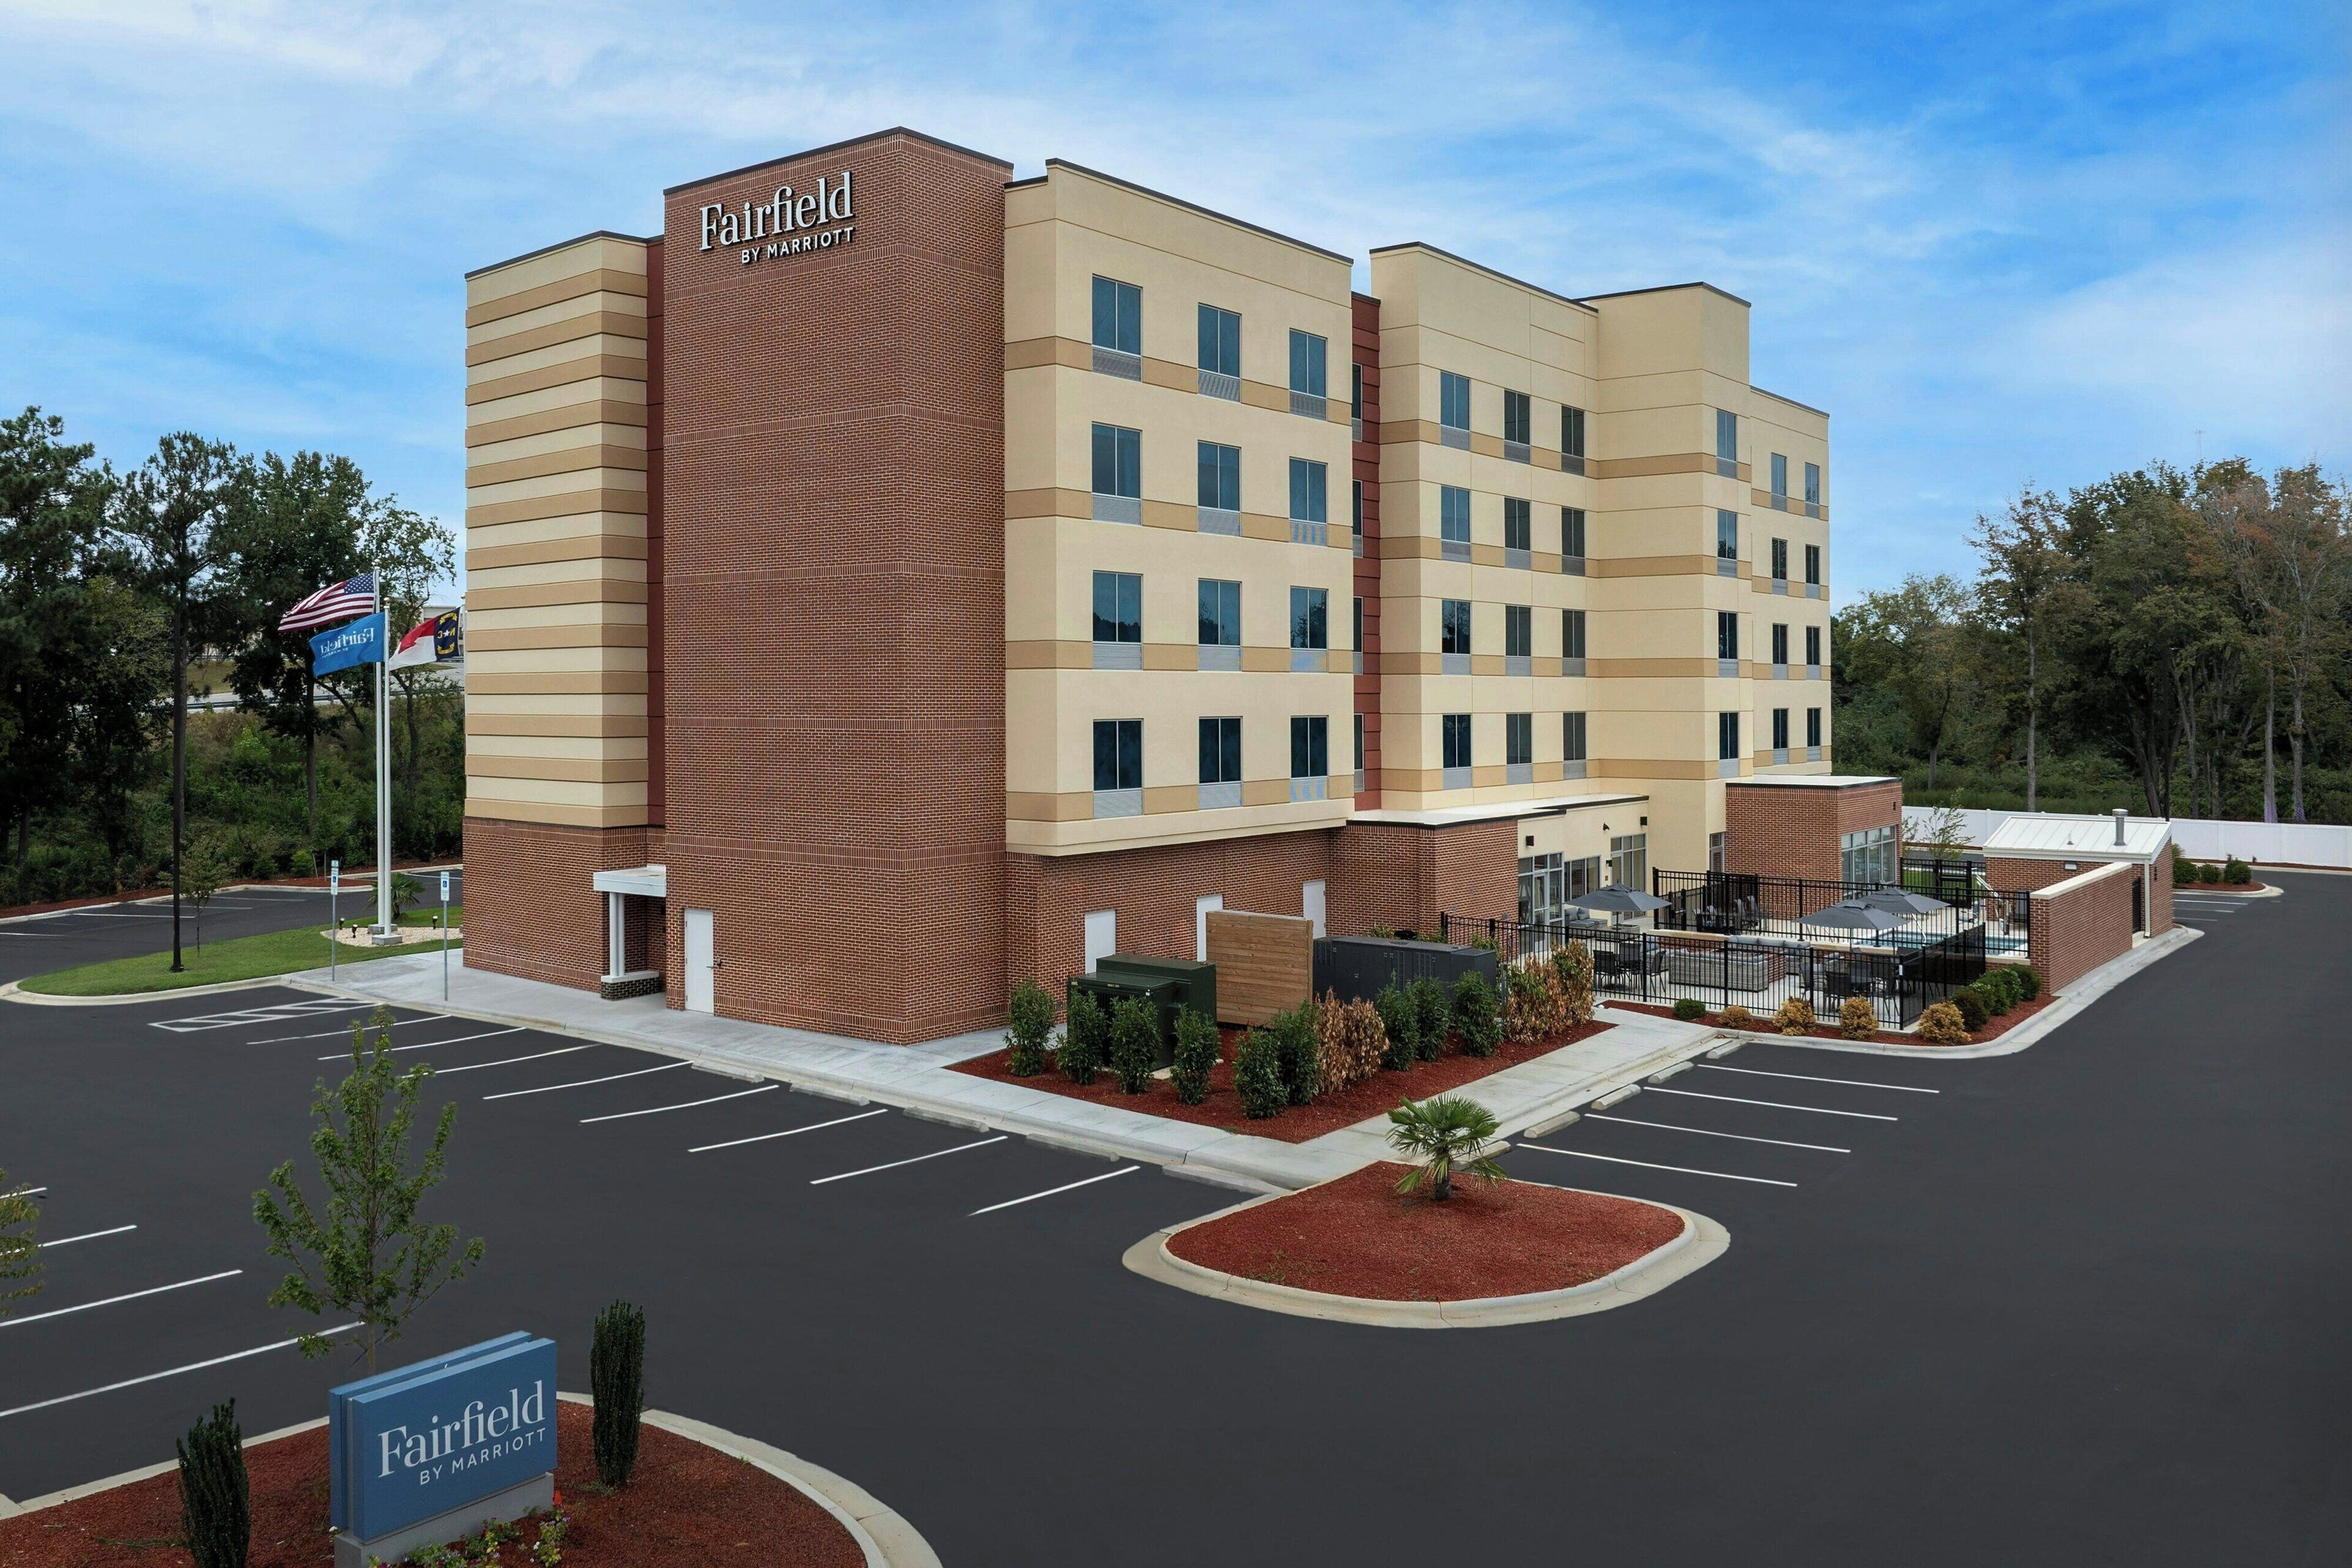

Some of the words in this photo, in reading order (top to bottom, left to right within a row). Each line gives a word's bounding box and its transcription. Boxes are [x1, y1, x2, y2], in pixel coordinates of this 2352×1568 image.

[699, 171, 853, 251] Fairfield
[741, 246, 761, 263] BY
[767, 227, 854, 259] MARRIOTT
[378, 1380, 545, 1478] Fairfield
[420, 1465, 442, 1485] BY
[452, 1428, 545, 1474] MARRIOTT
